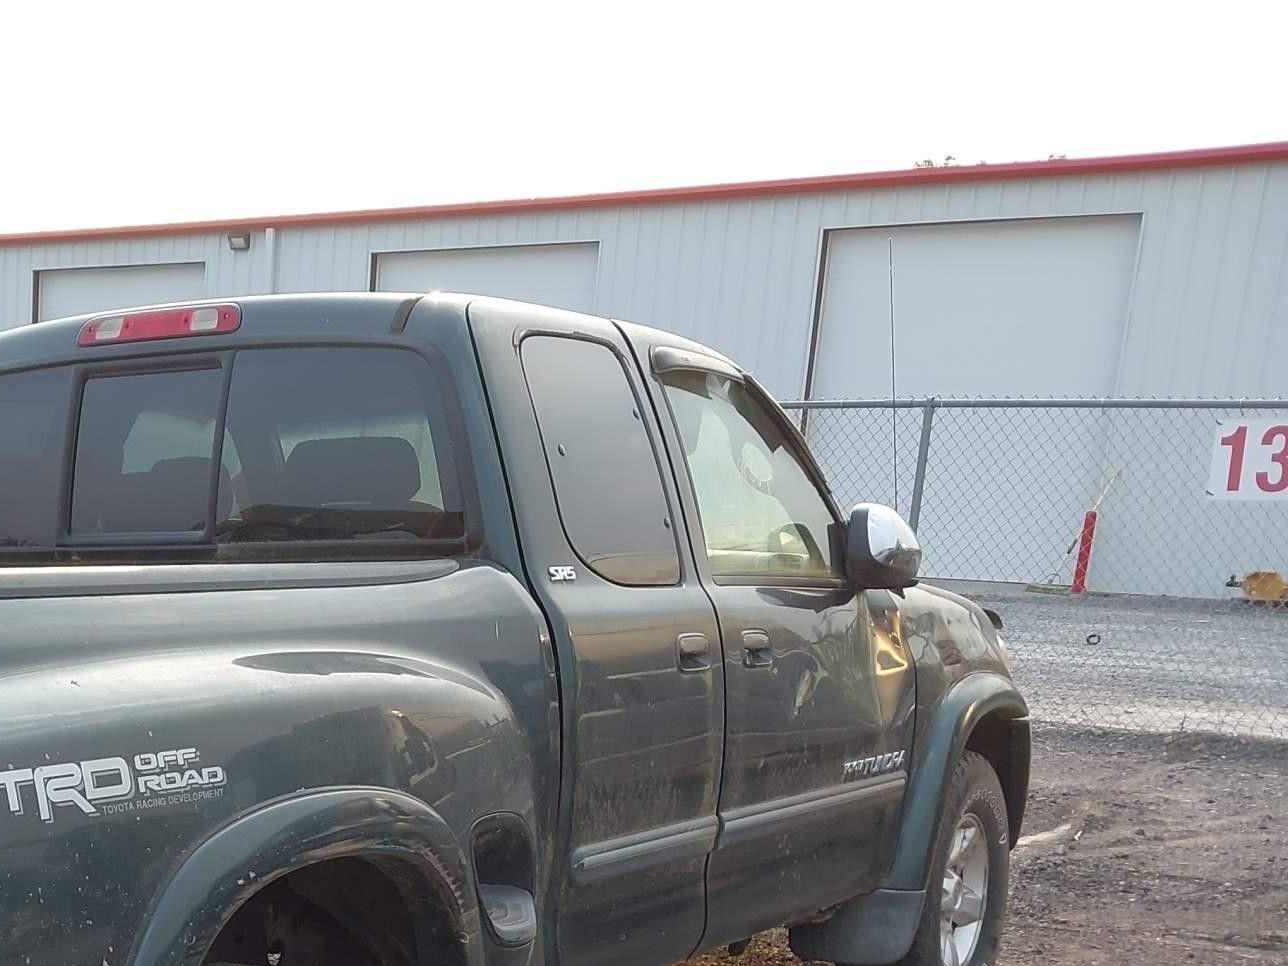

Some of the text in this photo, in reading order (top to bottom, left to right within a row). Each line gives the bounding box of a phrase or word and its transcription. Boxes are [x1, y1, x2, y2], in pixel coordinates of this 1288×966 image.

[1220, 425, 1288, 492] 13
[549, 566, 577, 581] SR5
[134, 748, 199, 772] OFF
[138, 766, 226, 795] ROAD
[103, 788, 225, 815] TOYOTA RACING DEVELOPMENT
